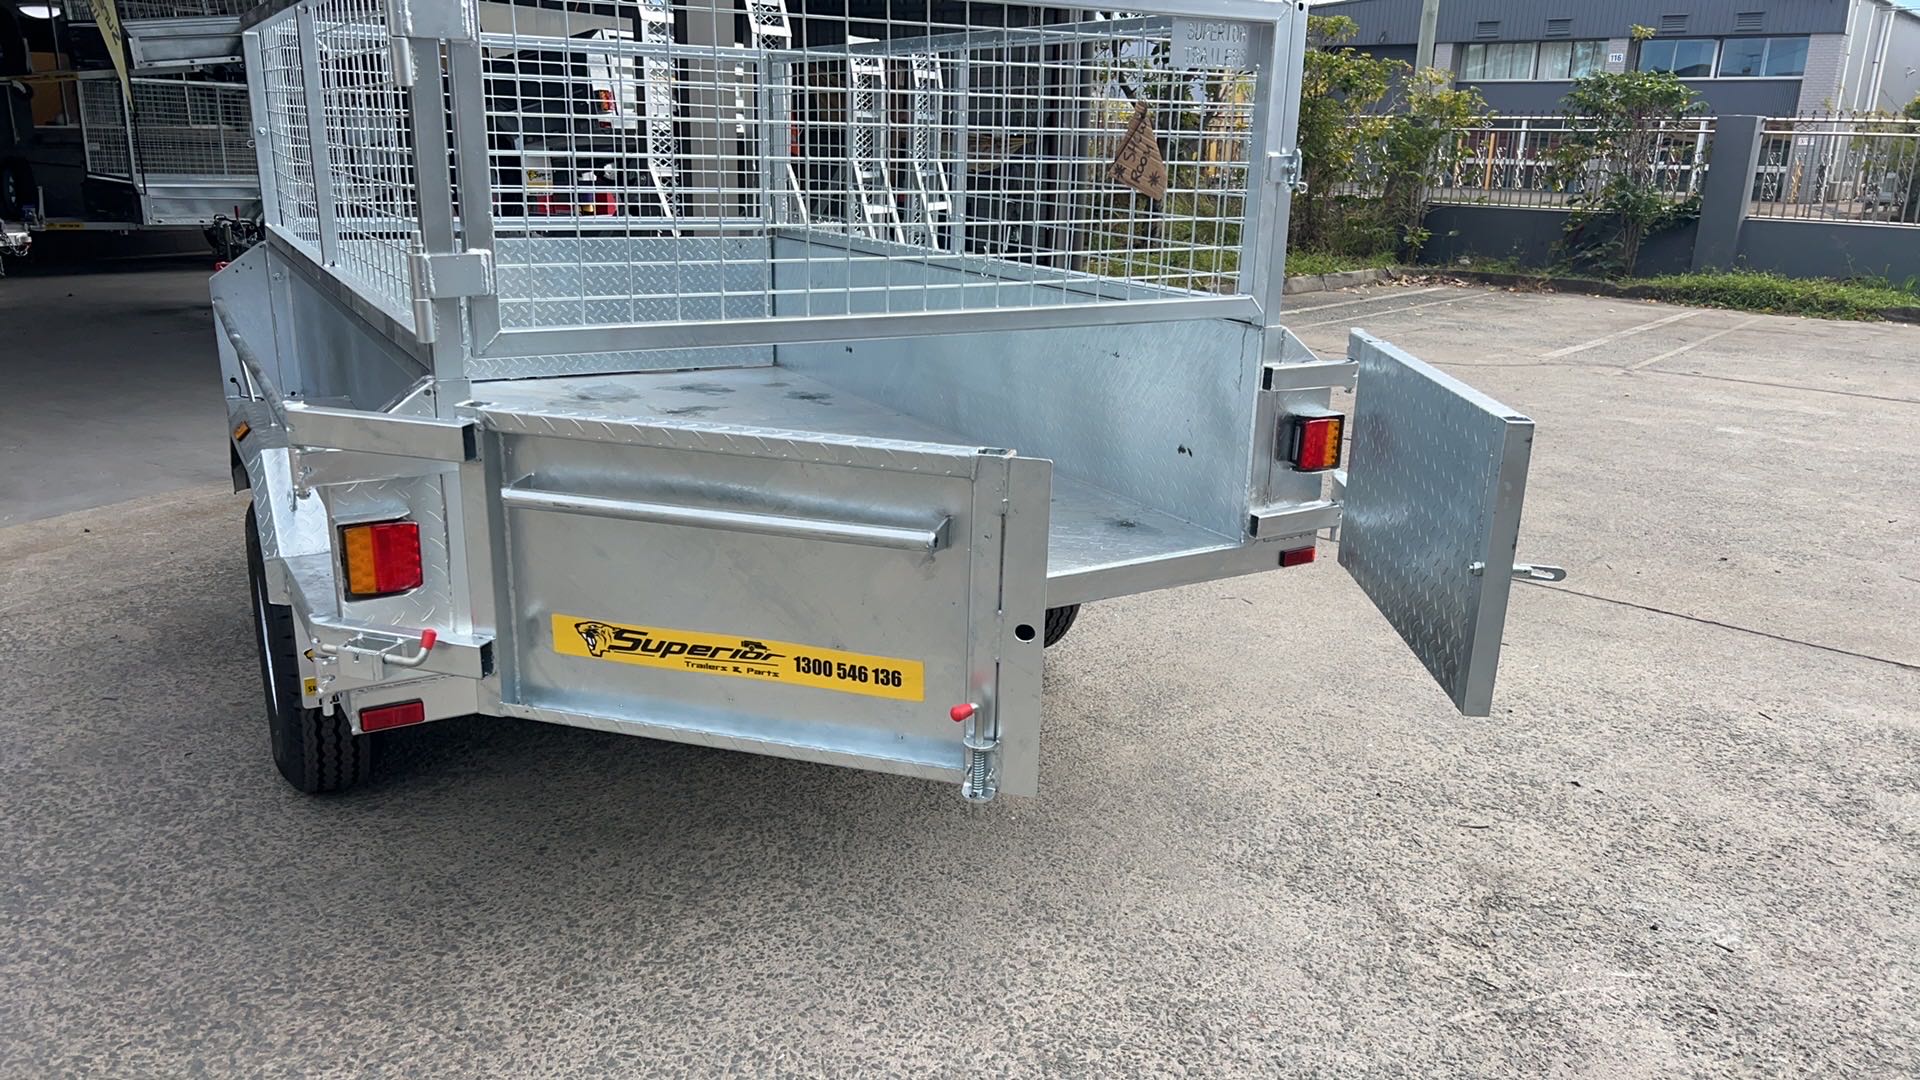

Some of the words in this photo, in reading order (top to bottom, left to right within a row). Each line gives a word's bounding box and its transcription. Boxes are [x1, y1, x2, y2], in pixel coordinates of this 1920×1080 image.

[1186, 21, 1248, 43] SUPERIOR
[608, 628, 787, 660] Superior
[794, 656, 833, 677] 1300
[837, 662, 868, 683] 546
[872, 667, 902, 687] 136
[747, 667, 780, 678] Parts
